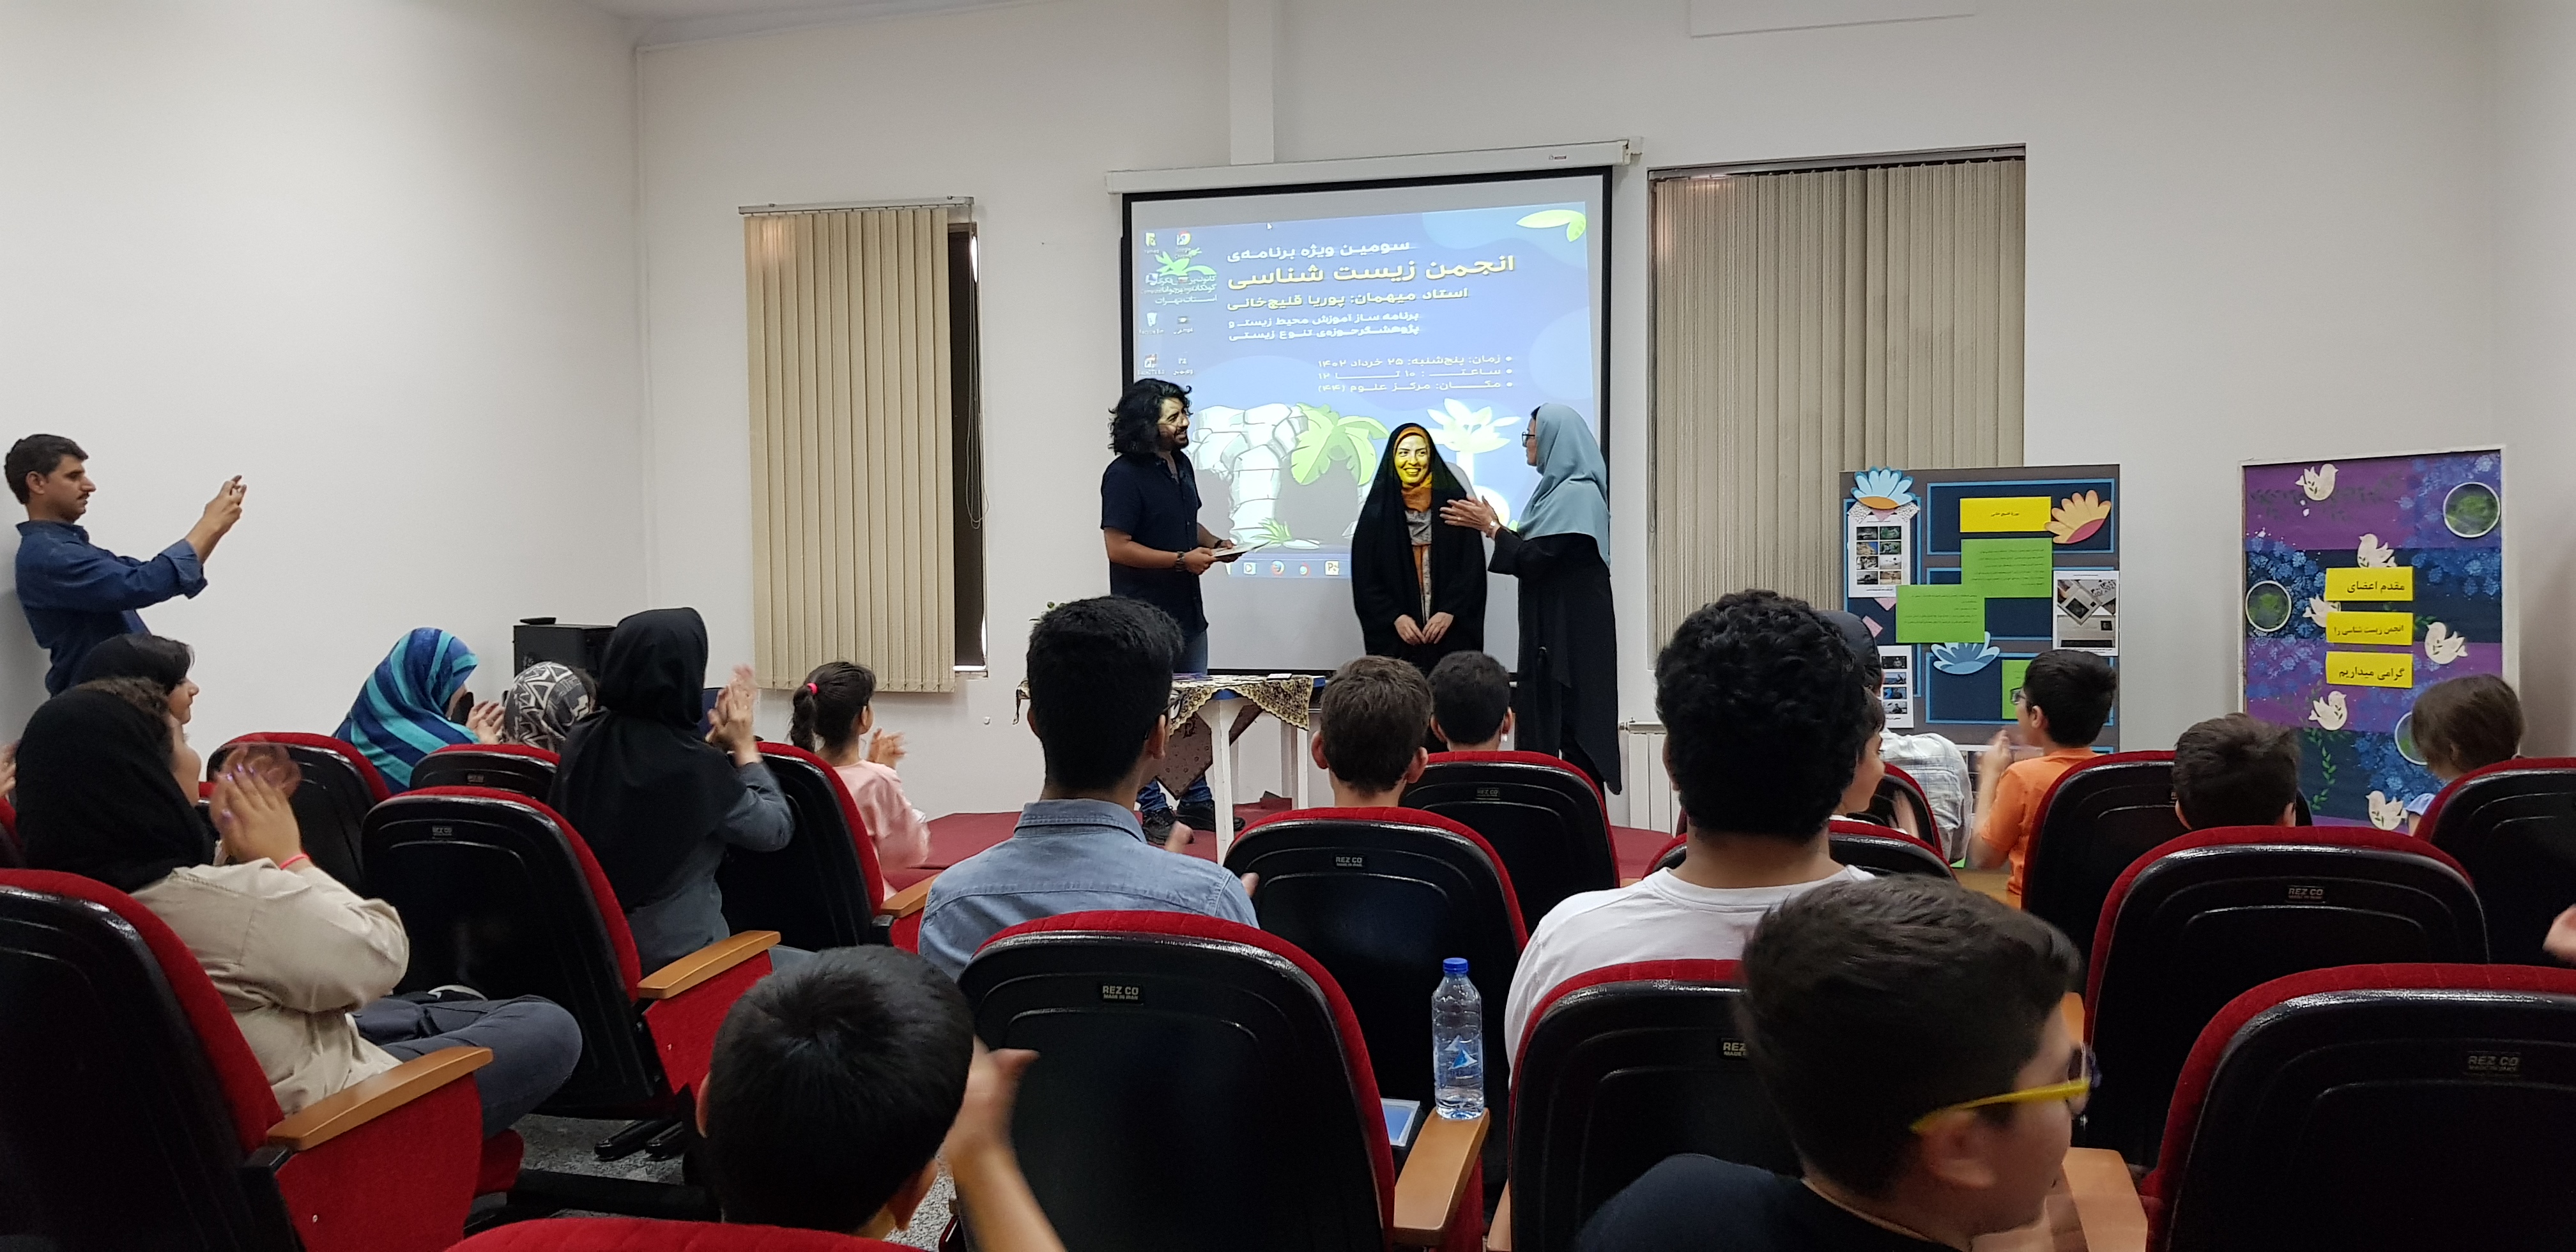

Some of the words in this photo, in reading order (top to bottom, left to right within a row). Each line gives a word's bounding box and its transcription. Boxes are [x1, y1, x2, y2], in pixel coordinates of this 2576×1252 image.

[1301, 243, 1335, 258] ویژه
[1340, 241, 1410, 256] سومین
[1333, 260, 1416, 282] زیست
[1425, 255, 1514, 280] انجمن
[1228, 264, 1324, 289] شناسی
[1350, 292, 1416, 305] میهمان:
[1422, 287, 1469, 300] استاد
[1308, 294, 1345, 307] پوریا
[1276, 317, 1309, 326] محیط
[1312, 314, 1353, 325] آموزش
[1354, 314, 1380, 324] ساز
[1382, 312, 1419, 321] برنامه
[1228, 321, 1235, 329] و
[1229, 330, 1275, 342] زیستی
[1279, 329, 1312, 339] تنوع
[1350, 358, 1383, 368] خرداد
[1468, 355, 1501, 365] زمان:
[1350, 383, 1387, 392] علوم
[1392, 382, 1431, 392] مرکز
[2347, 581, 2377, 593] اعضای
[2380, 581, 2405, 593] مقدم
[2384, 625, 2404, 634] انجمن
[2377, 668, 2405, 680] گرامی
[1103, 986, 1123, 994] REZ
[1124, 986, 1138, 995] CO
[1723, 1042, 1747, 1051] REZ
[2468, 1056, 2496, 1065] REZ
[2499, 1057, 2519, 1065] CO
